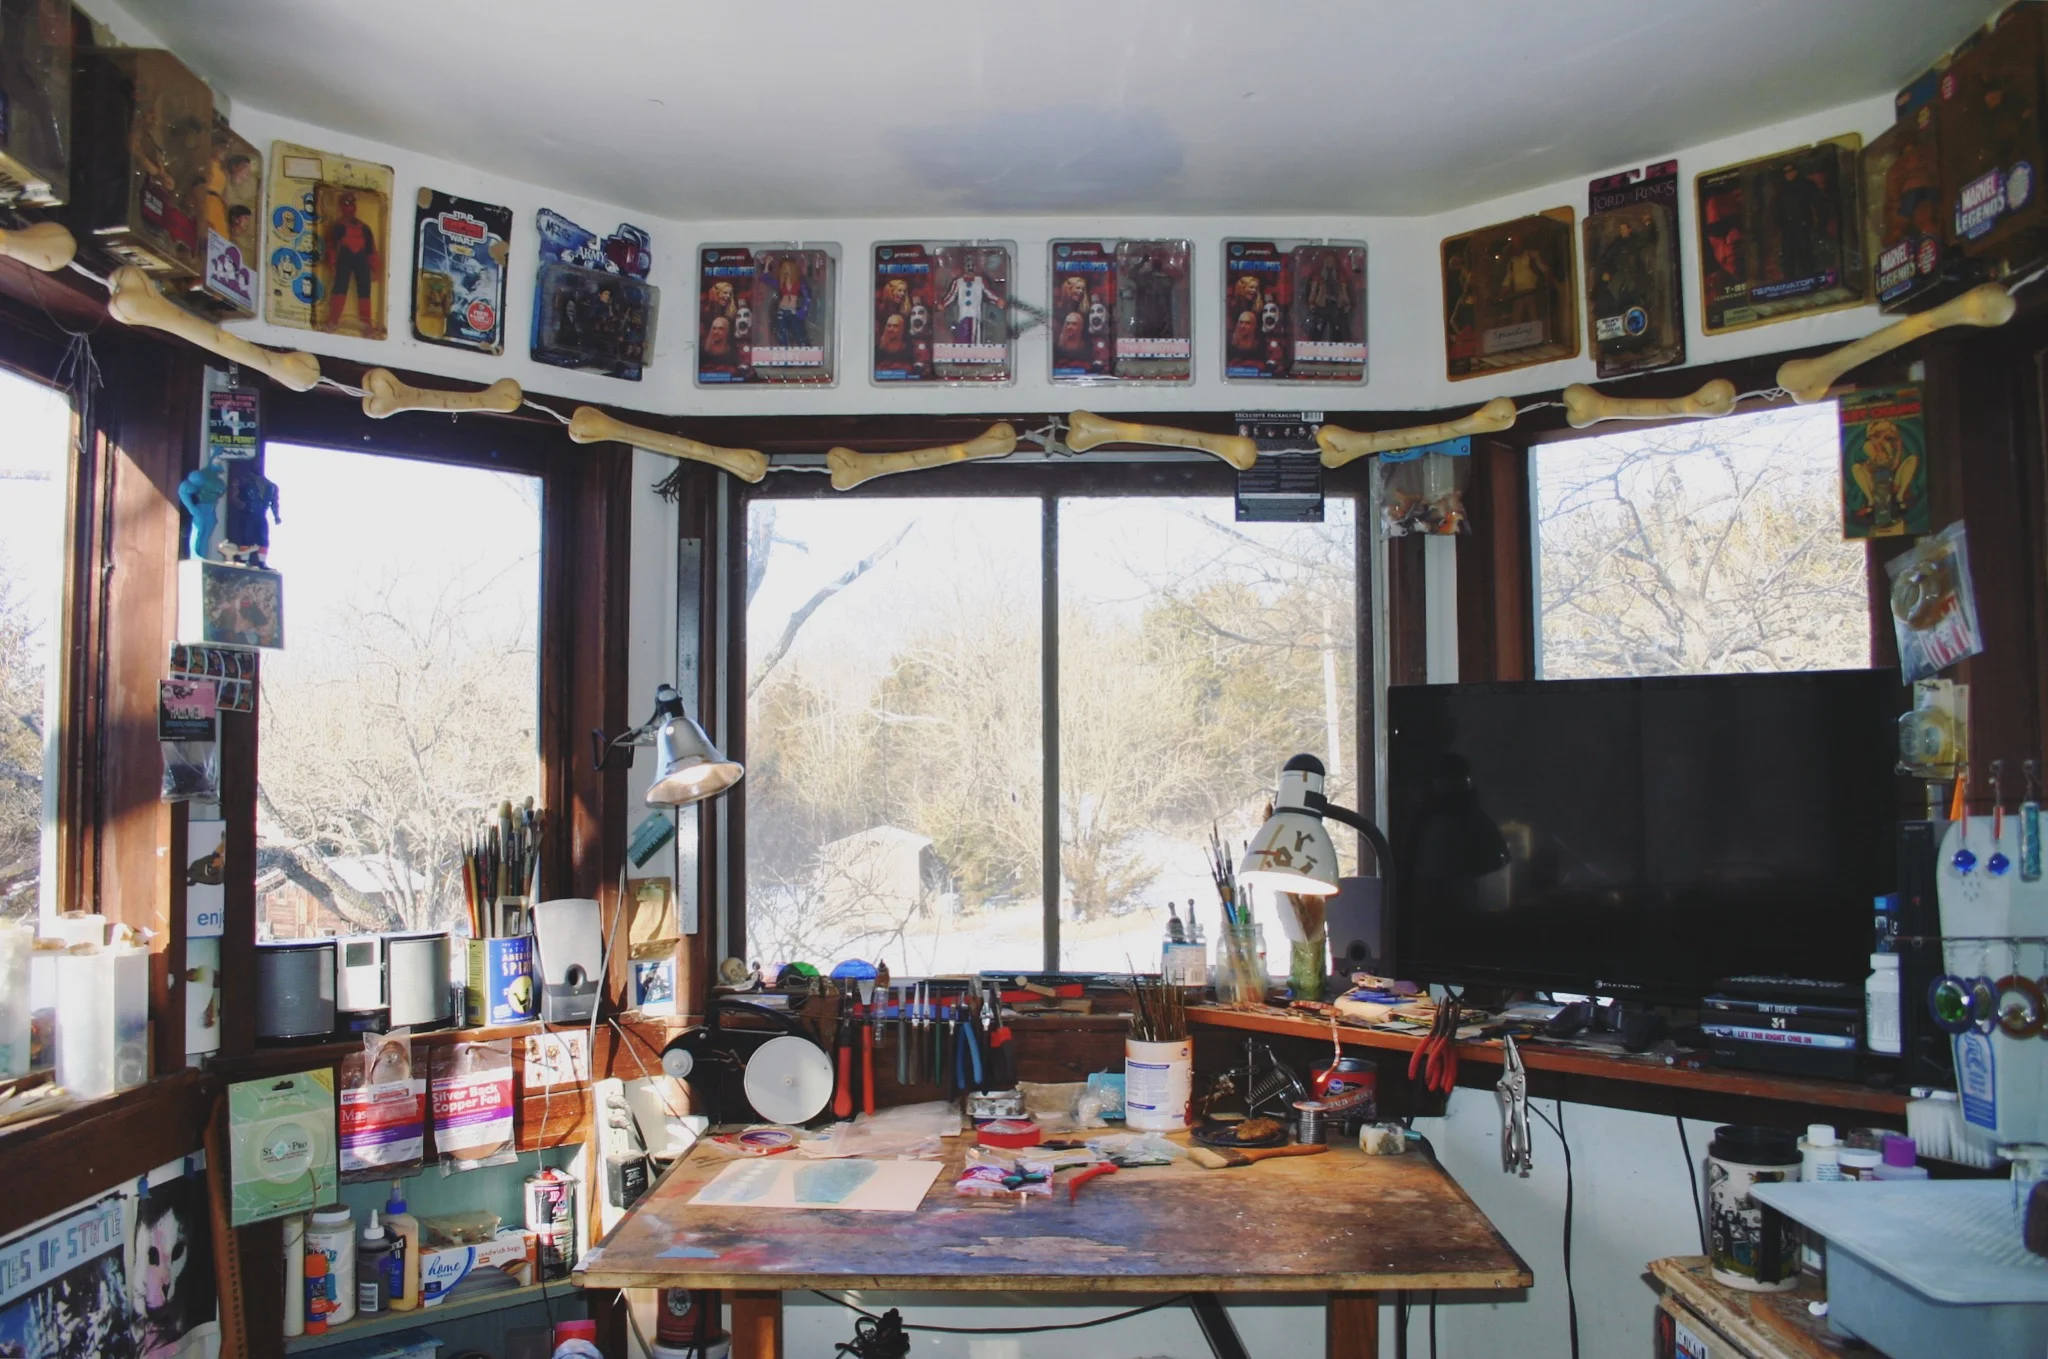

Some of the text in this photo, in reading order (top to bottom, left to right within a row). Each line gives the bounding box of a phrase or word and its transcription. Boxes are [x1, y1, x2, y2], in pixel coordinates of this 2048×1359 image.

[1635, 180, 1675, 201] RINGS
[1961, 171, 1998, 212] MARVEL
[452, 210, 475, 221] STAR
[1955, 194, 2005, 236] LEGENDS
[449, 234, 475, 246] WARS
[575, 245, 608, 264] ARMY
[1880, 240, 1908, 274] MARVEL
[1751, 278, 1815, 296] TERMINATOR
[197, 908, 225, 928] enj
[1775, 1005, 1798, 1014] BREATHE
[1771, 1017, 1786, 1029] 31
[1737, 1030, 1748, 1038] LET
[1751, 1031, 1764, 1039] THE
[1765, 1033, 1786, 1041] RIGHT
[1787, 1035, 1802, 1043] ONE
[432, 1084, 498, 1103] Silver Back
[433, 1093, 502, 1113] Copper Foil
[38, 1237, 60, 1272] OF
[67, 1207, 121, 1260] STATE
[478, 1246, 506, 1258] sandwich
[428, 1256, 461, 1276] home
